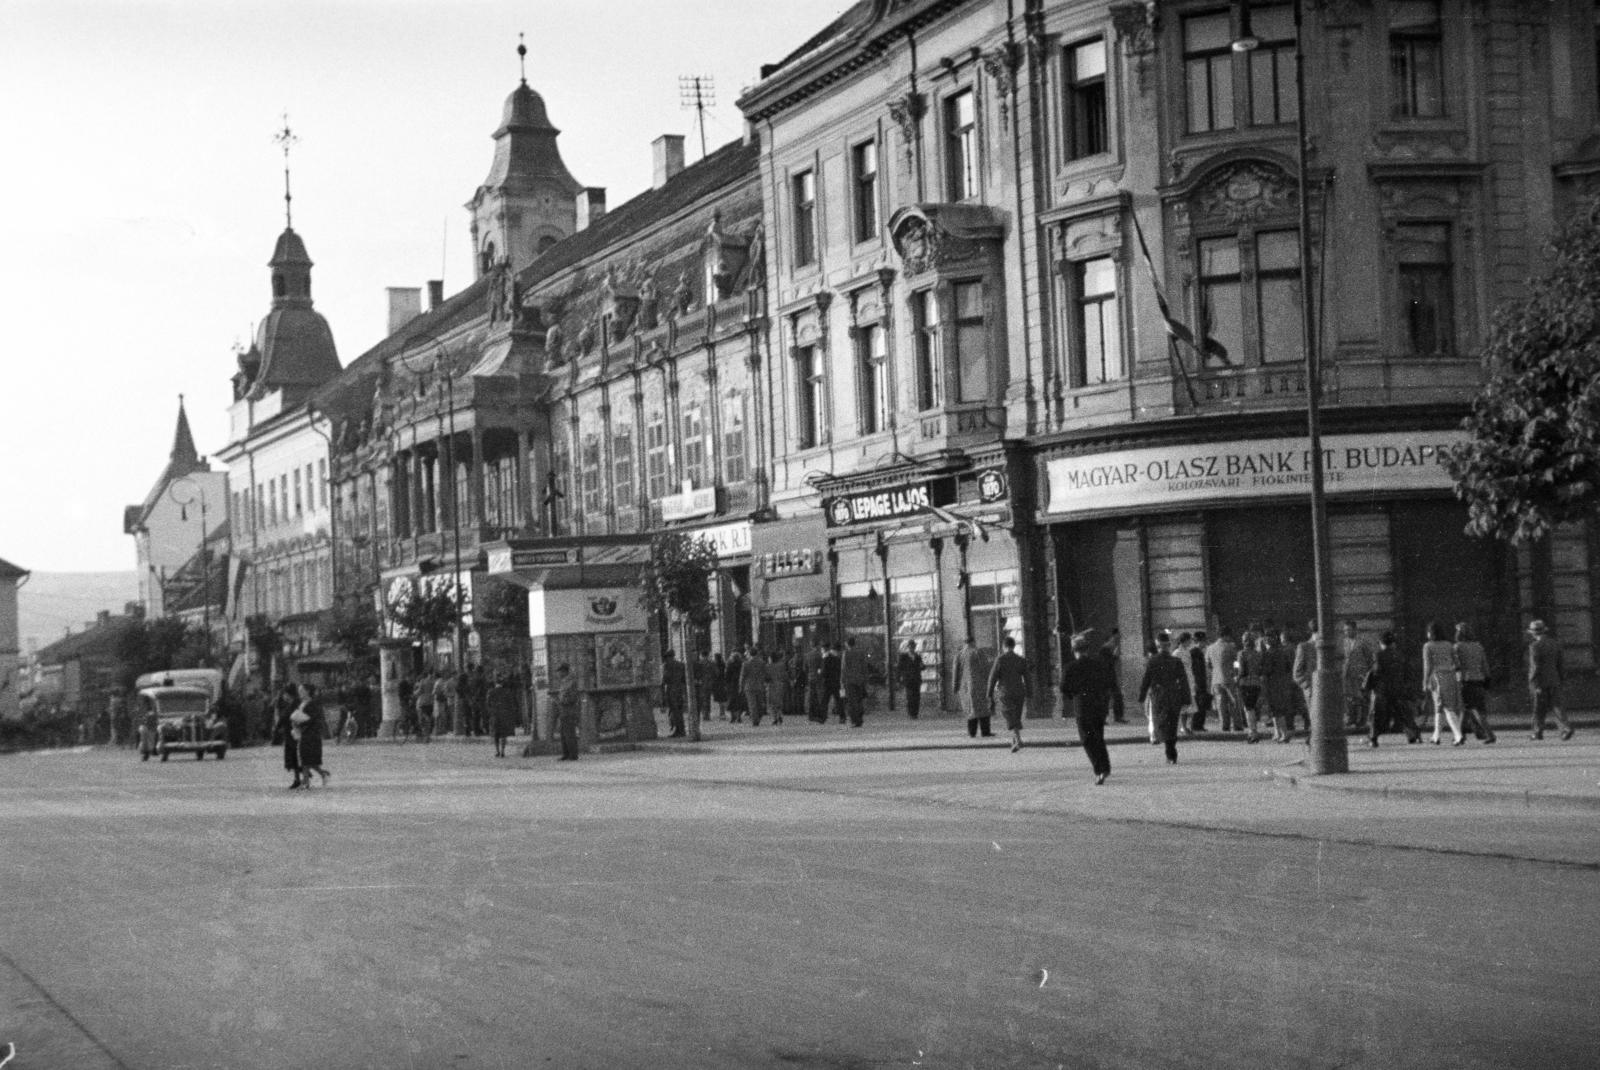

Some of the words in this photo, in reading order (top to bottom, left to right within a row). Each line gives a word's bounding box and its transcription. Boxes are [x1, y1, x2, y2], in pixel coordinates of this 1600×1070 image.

[1068, 456, 1219, 489] MAGYAR-OLASZ
[1226, 451, 1294, 475] BANK
[852, 493, 892, 520] LEPAGE
[892, 486, 930, 514] LAJOS
